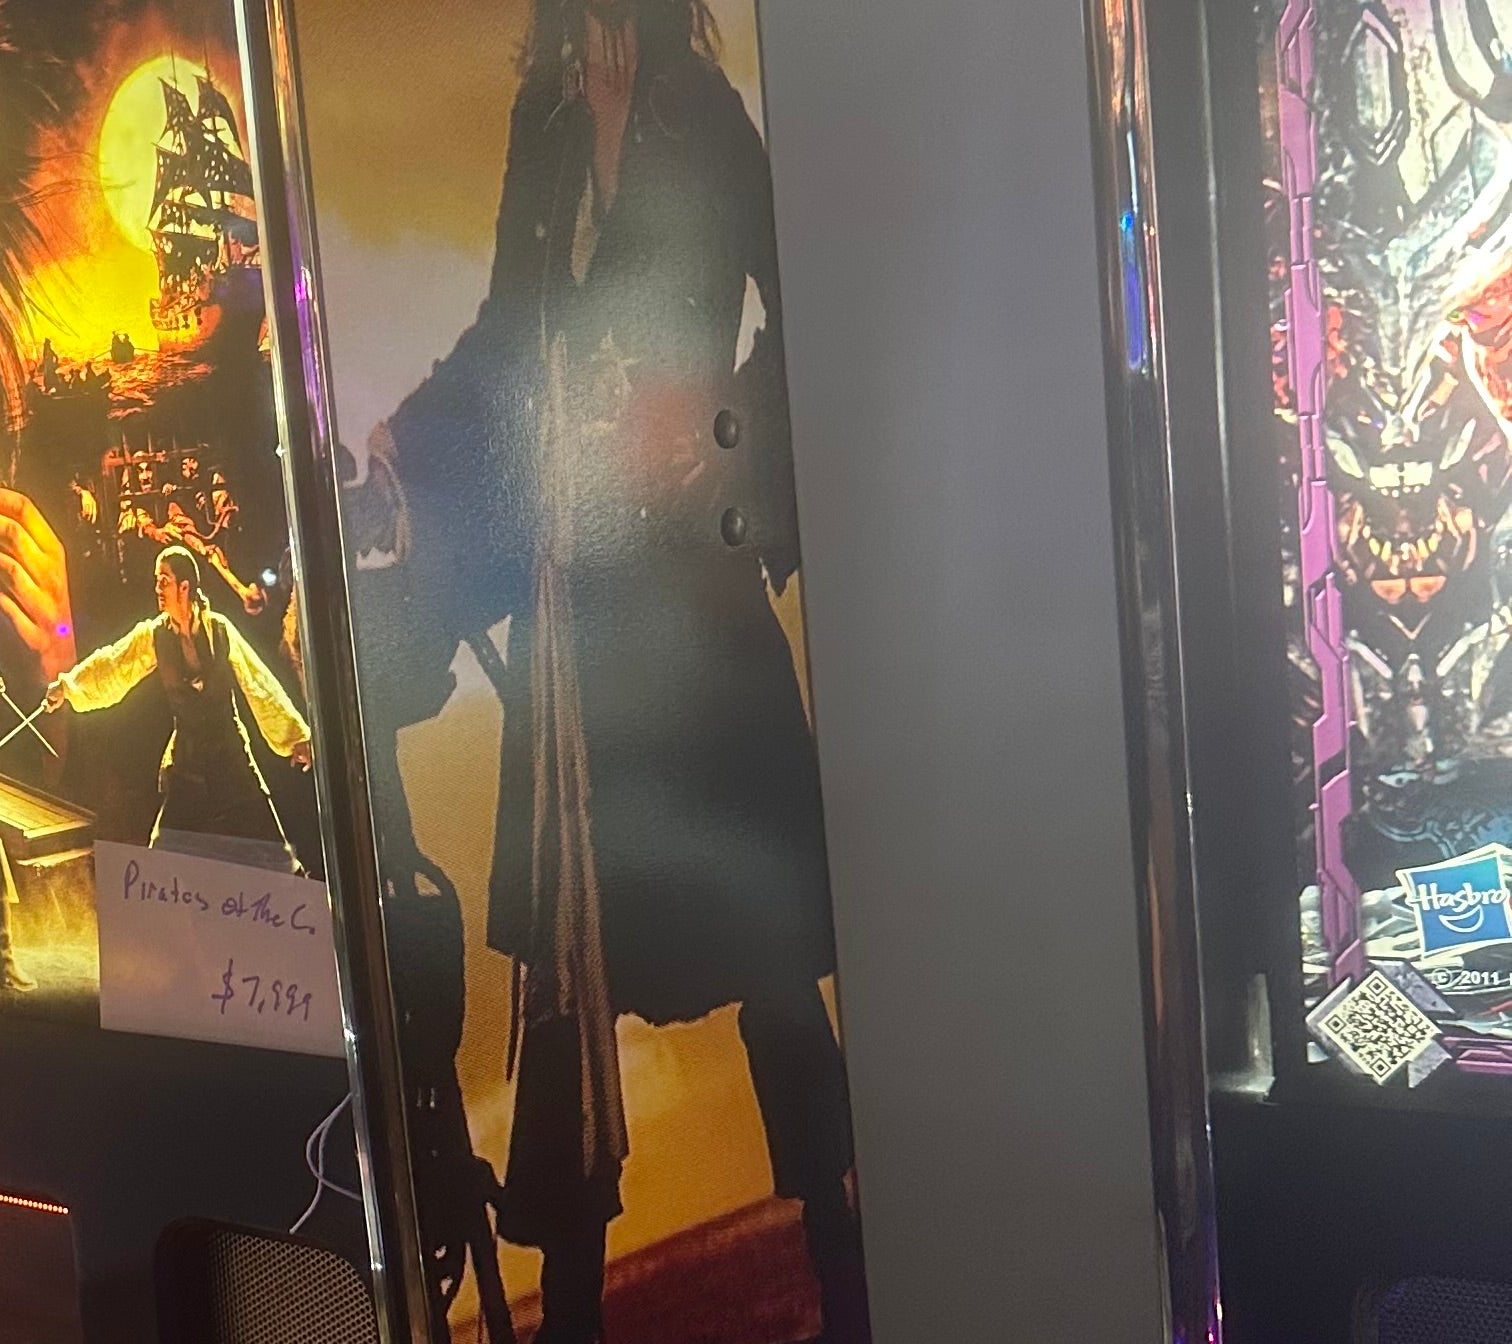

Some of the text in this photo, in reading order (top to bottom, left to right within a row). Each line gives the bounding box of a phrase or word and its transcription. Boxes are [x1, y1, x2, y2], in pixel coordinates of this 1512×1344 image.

[123, 859, 209, 910] Pirates
[1405, 882, 1509, 913] Hasbro
[211, 958, 312, 1021] $7,999
[1459, 970, 1500, 986] 2011
